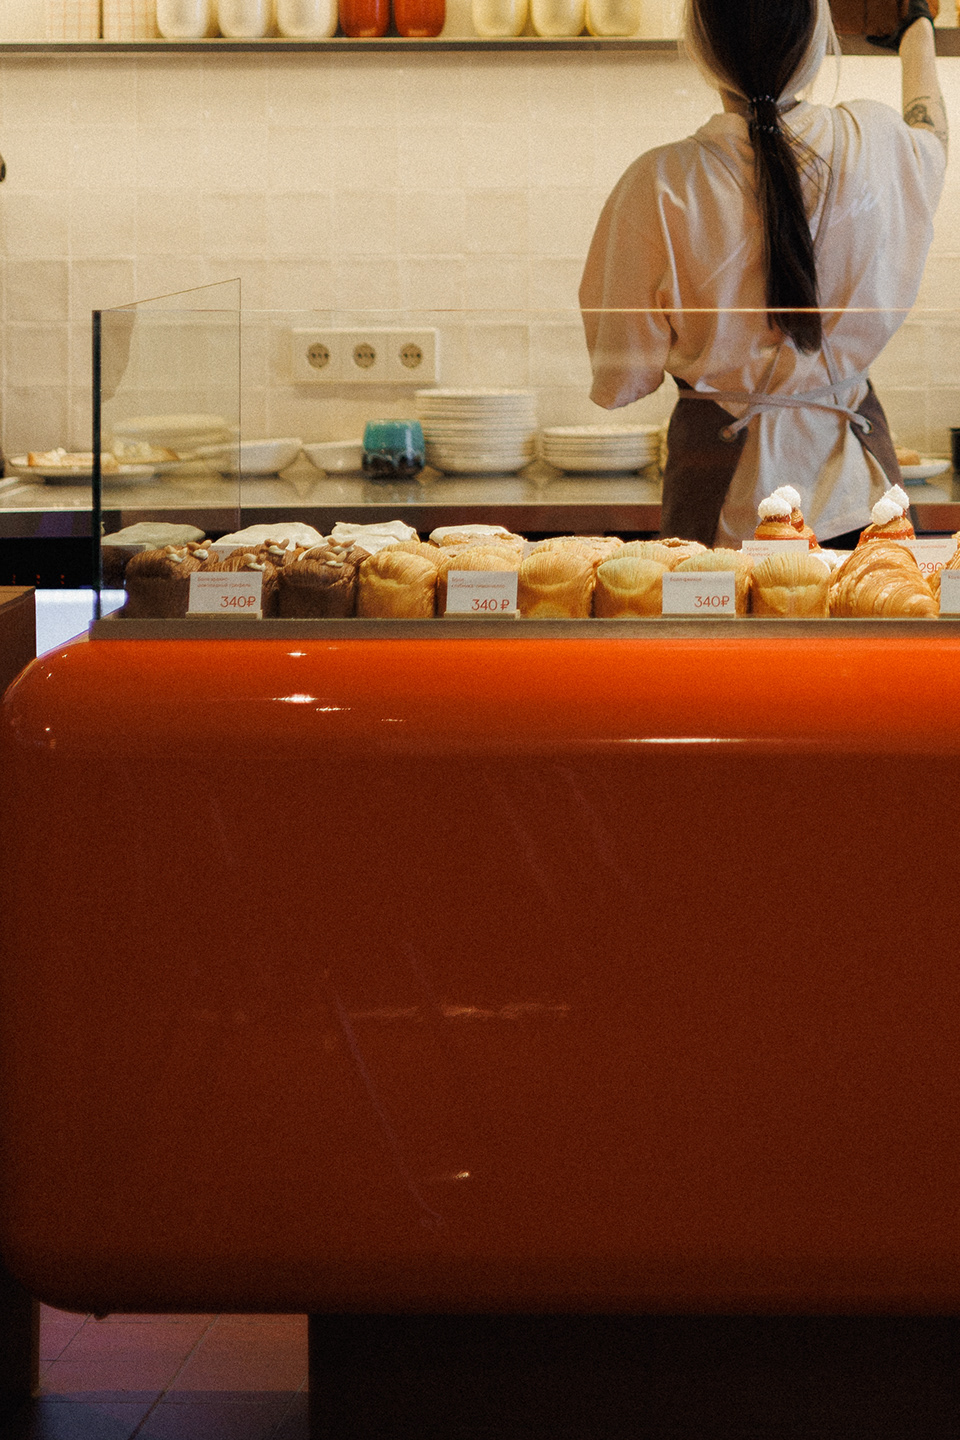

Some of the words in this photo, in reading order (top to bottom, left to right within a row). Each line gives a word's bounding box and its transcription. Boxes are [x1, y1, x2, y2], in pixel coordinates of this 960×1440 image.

[220, 596, 256, 608] 340₽
[471, 599, 497, 611] 340
[694, 595, 730, 608] 340₽
